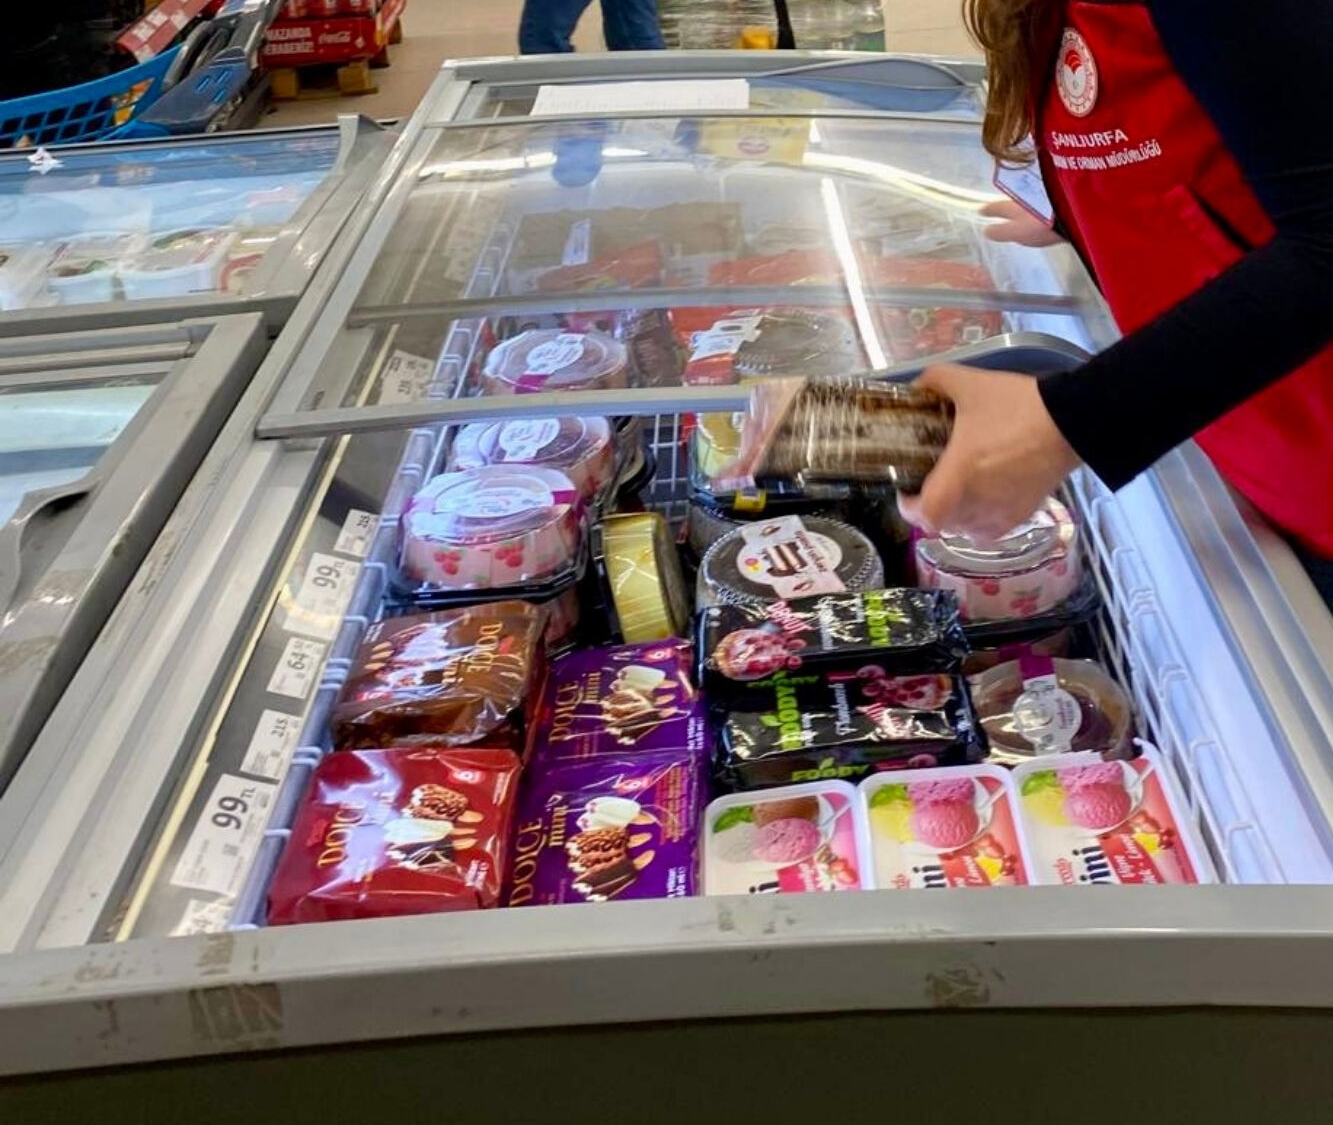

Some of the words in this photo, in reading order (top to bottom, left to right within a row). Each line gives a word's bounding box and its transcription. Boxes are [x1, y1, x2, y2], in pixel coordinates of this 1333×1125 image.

[265, 27, 312, 41] MAZANDA
[1052, 128, 1129, 150] ŞANLIURFA
[312, 564, 341, 590] 99
[287, 651, 310, 670] 64
[212, 795, 248, 830] 99
